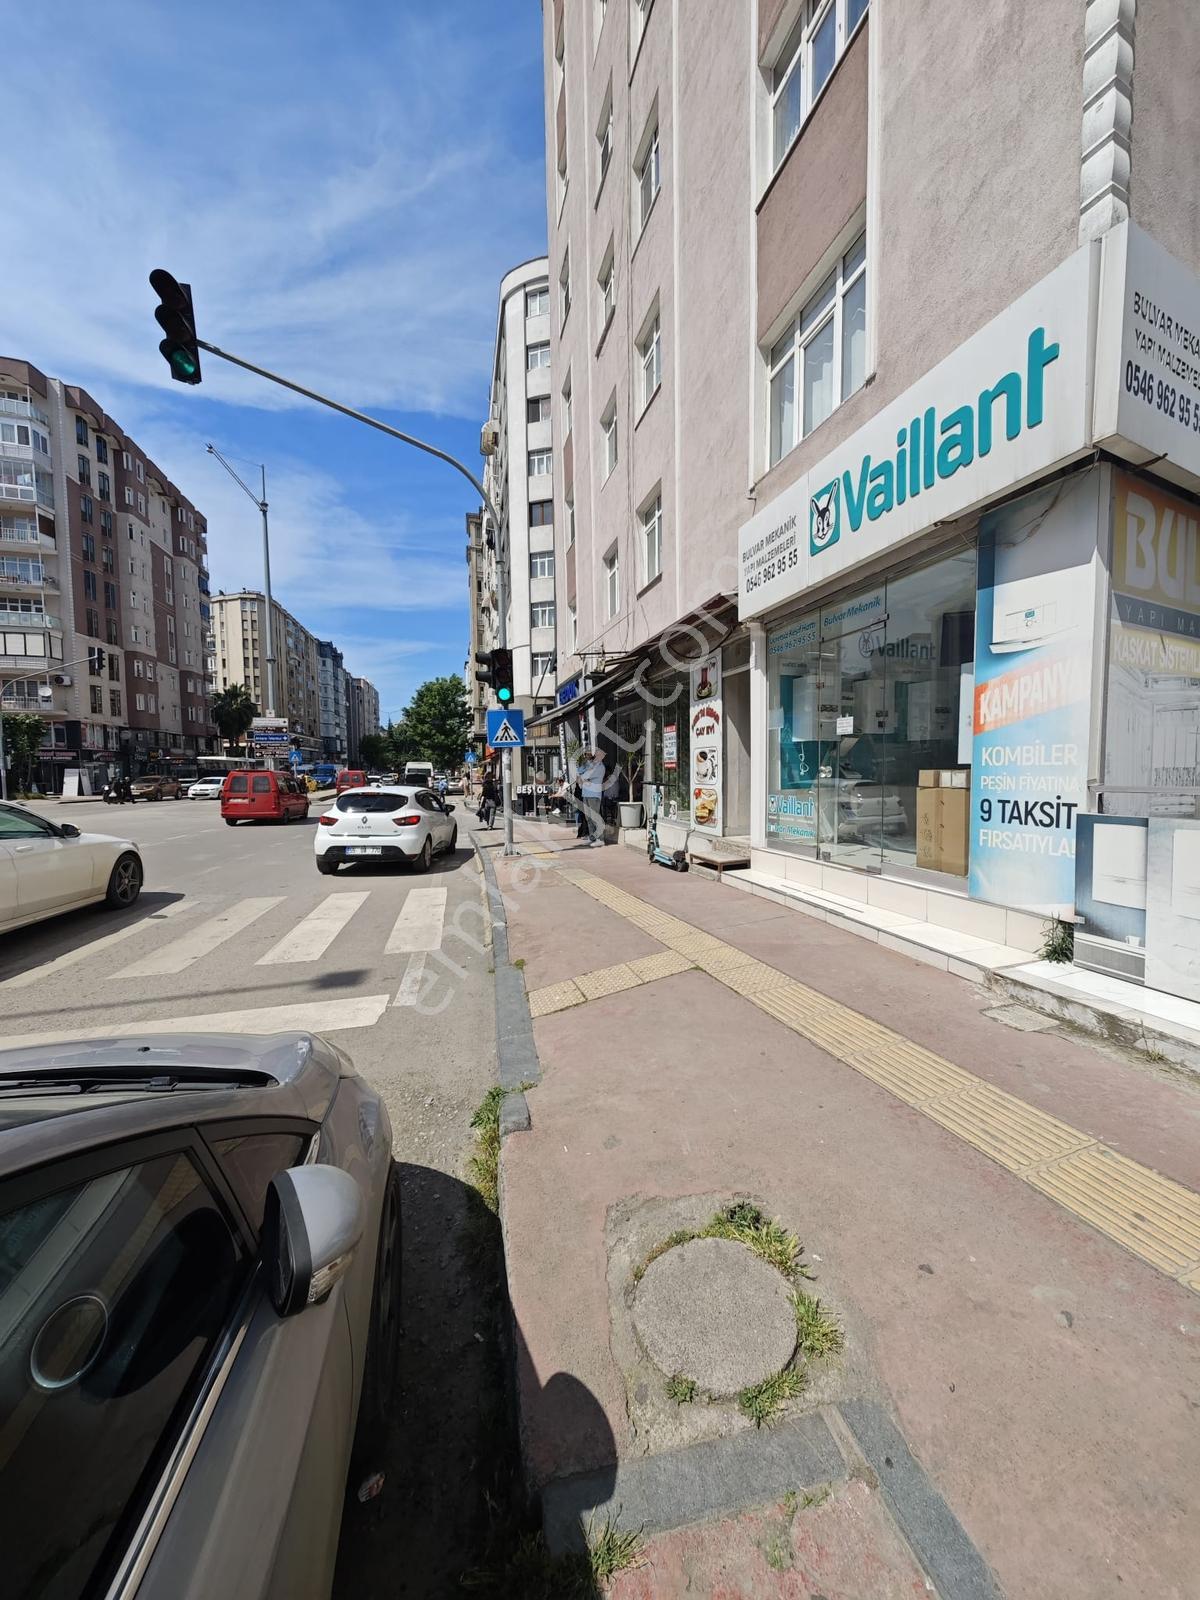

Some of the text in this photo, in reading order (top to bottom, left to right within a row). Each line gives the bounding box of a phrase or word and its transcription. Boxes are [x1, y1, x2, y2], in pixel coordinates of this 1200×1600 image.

[1133, 290, 1173, 340] BULVAR
[1134, 327, 1156, 359] YAPI
[1125, 359, 1154, 405] 0546
[1156, 379, 1175, 419] 962
[1178, 393, 1191, 427] 95
[842, 326, 1060, 532] Vaillant
[742, 514, 797, 564] BULVAR MEKANİK
[743, 530, 797, 577] YAPI MALZEMELERİ
[746, 548, 798, 593] 0546 962 95 55
[845, 595, 881, 618] Mekanik
[1126, 603, 1165, 628] YAPI
[981, 739, 1080, 768] KOMBİLER
[980, 773, 1018, 794] PEŞİN
[979, 794, 1079, 830] 9 TAKSİT
